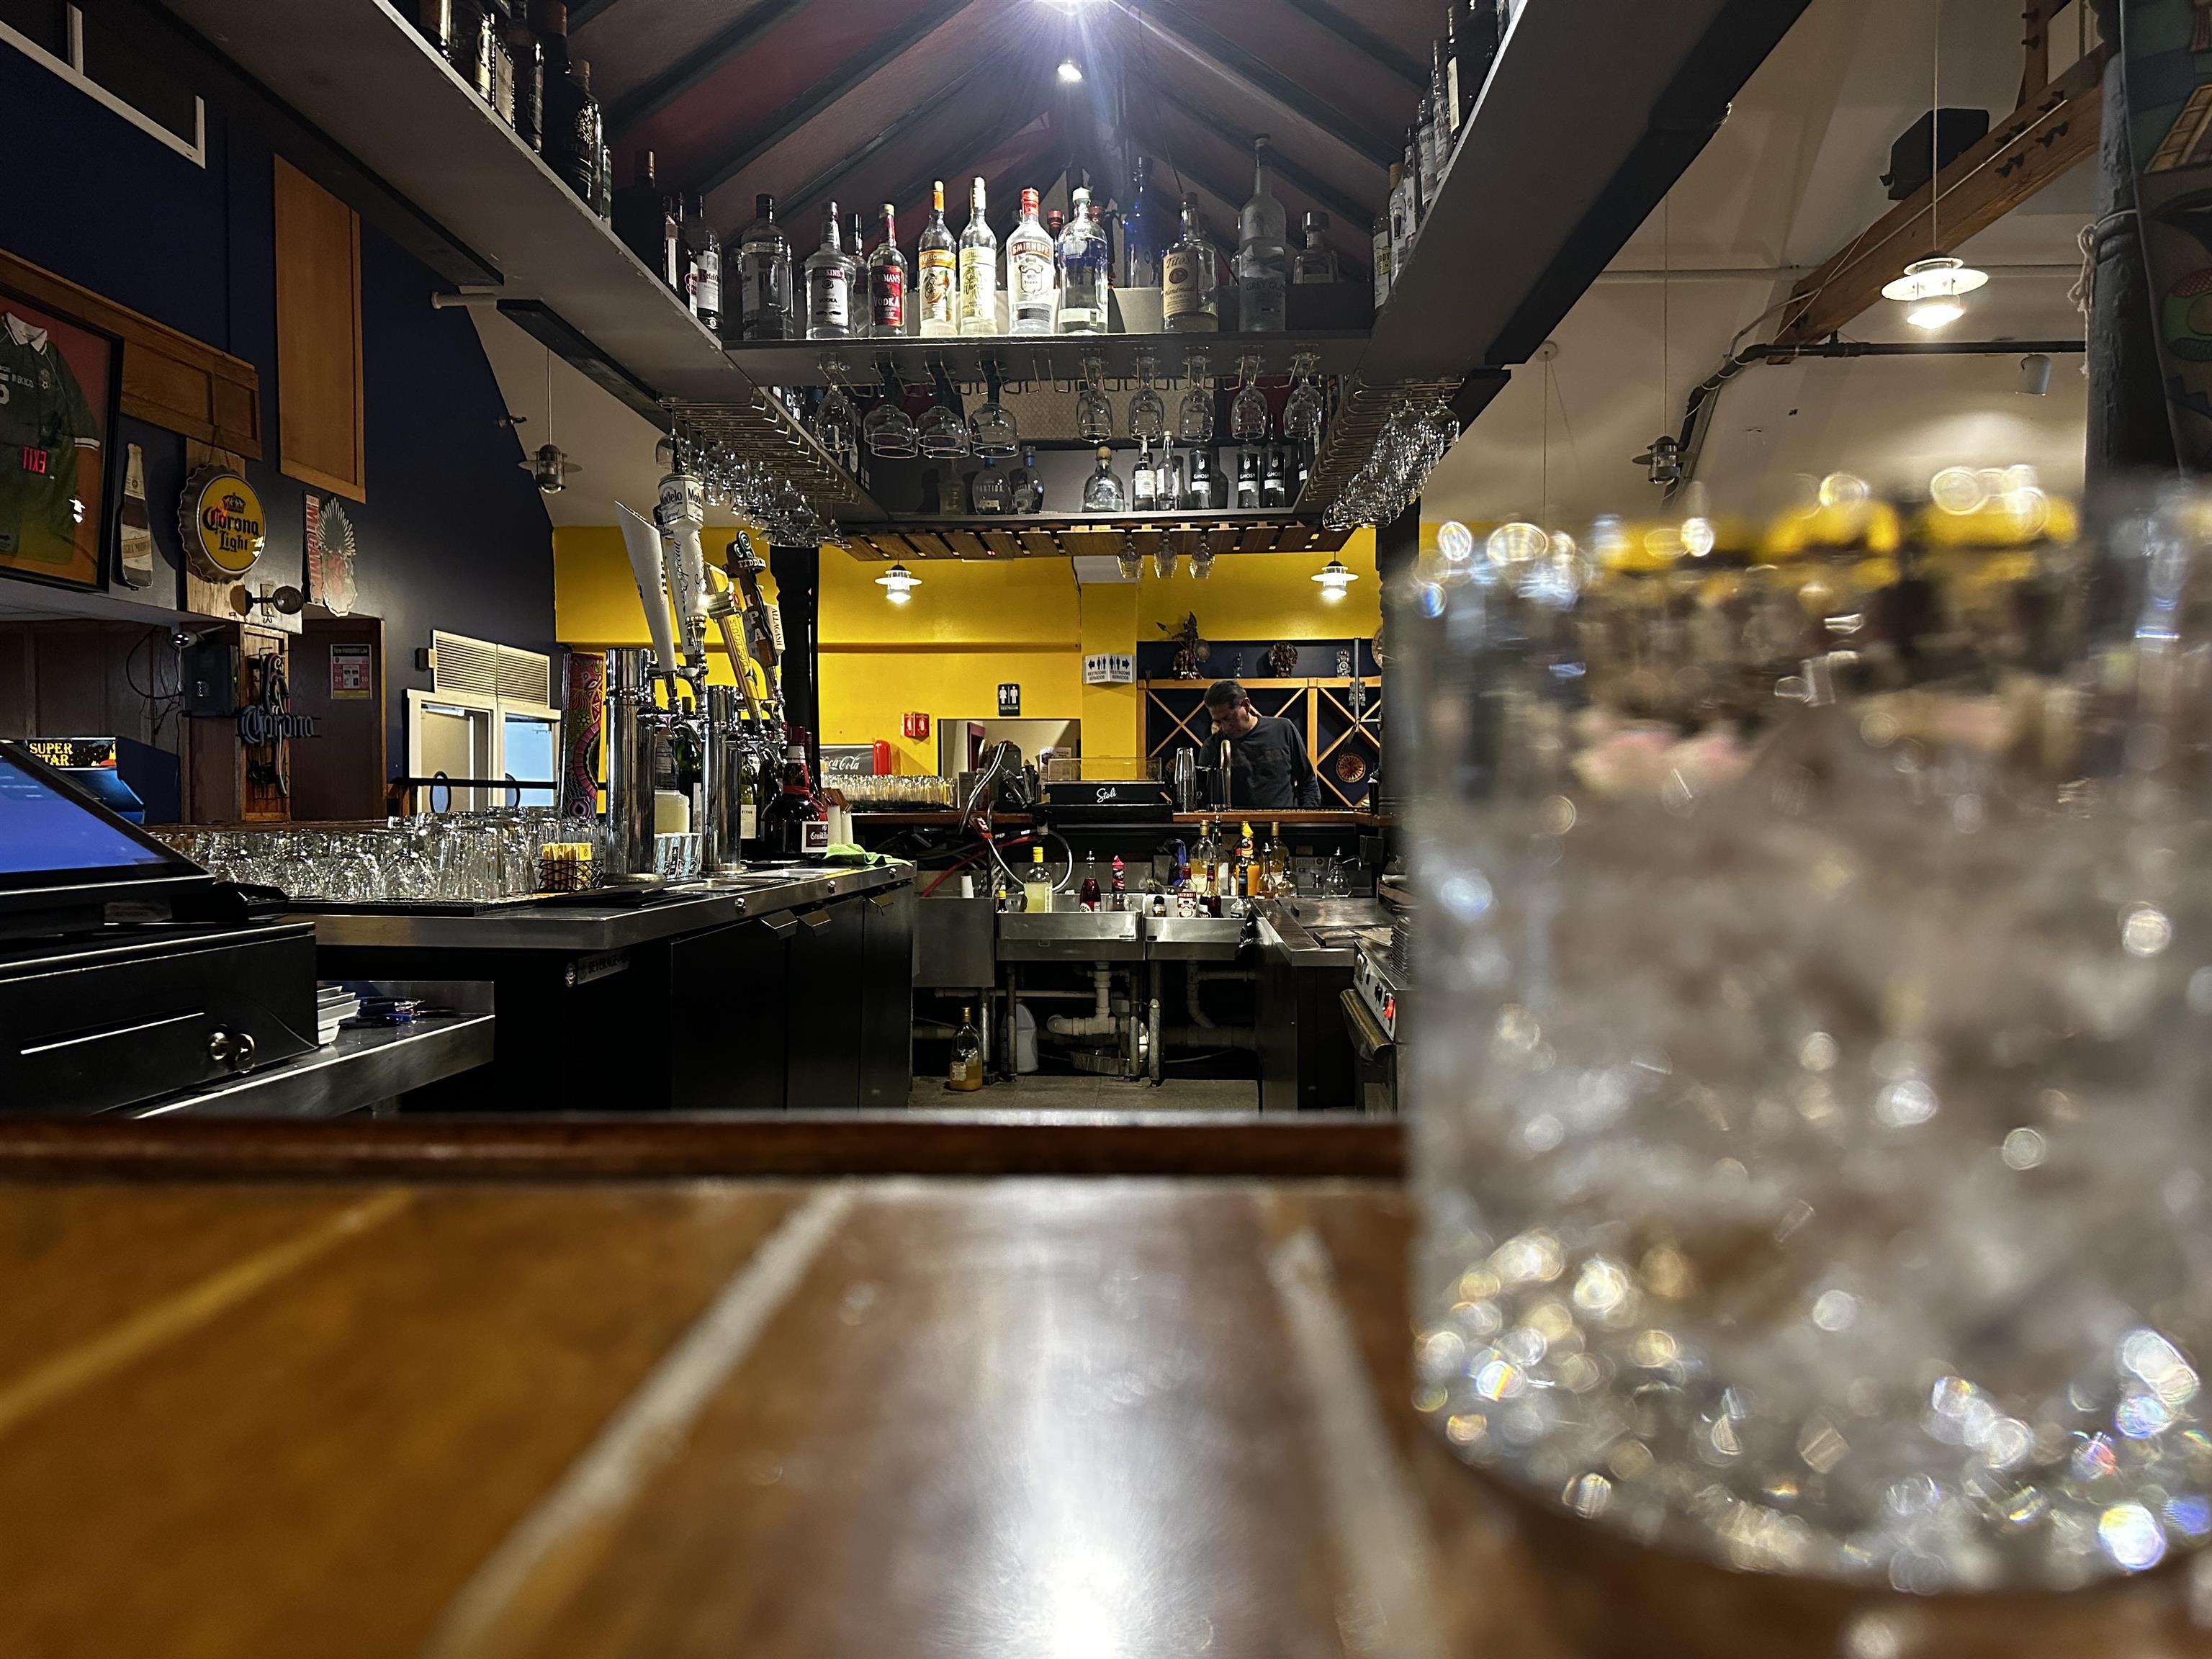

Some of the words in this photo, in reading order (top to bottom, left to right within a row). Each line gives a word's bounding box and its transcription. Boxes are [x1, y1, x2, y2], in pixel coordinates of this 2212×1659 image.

[1012, 242, 1049, 256] SMIRNOFF
[1166, 254, 1190, 269] Tito's
[873, 296, 900, 307] VODKA
[660, 489, 683, 505] Modelo
[202, 506, 259, 536] Corona
[219, 530, 248, 553] Light
[745, 594, 766, 642] IPA
[771, 608, 783, 646] ALLAGASH
[241, 704, 315, 747] Corona
[30, 742, 73, 755] SUPER
[35, 754, 71, 766] TAR
[829, 755, 860, 770] ca-Cola
[1096, 786, 1118, 804] Stoli
